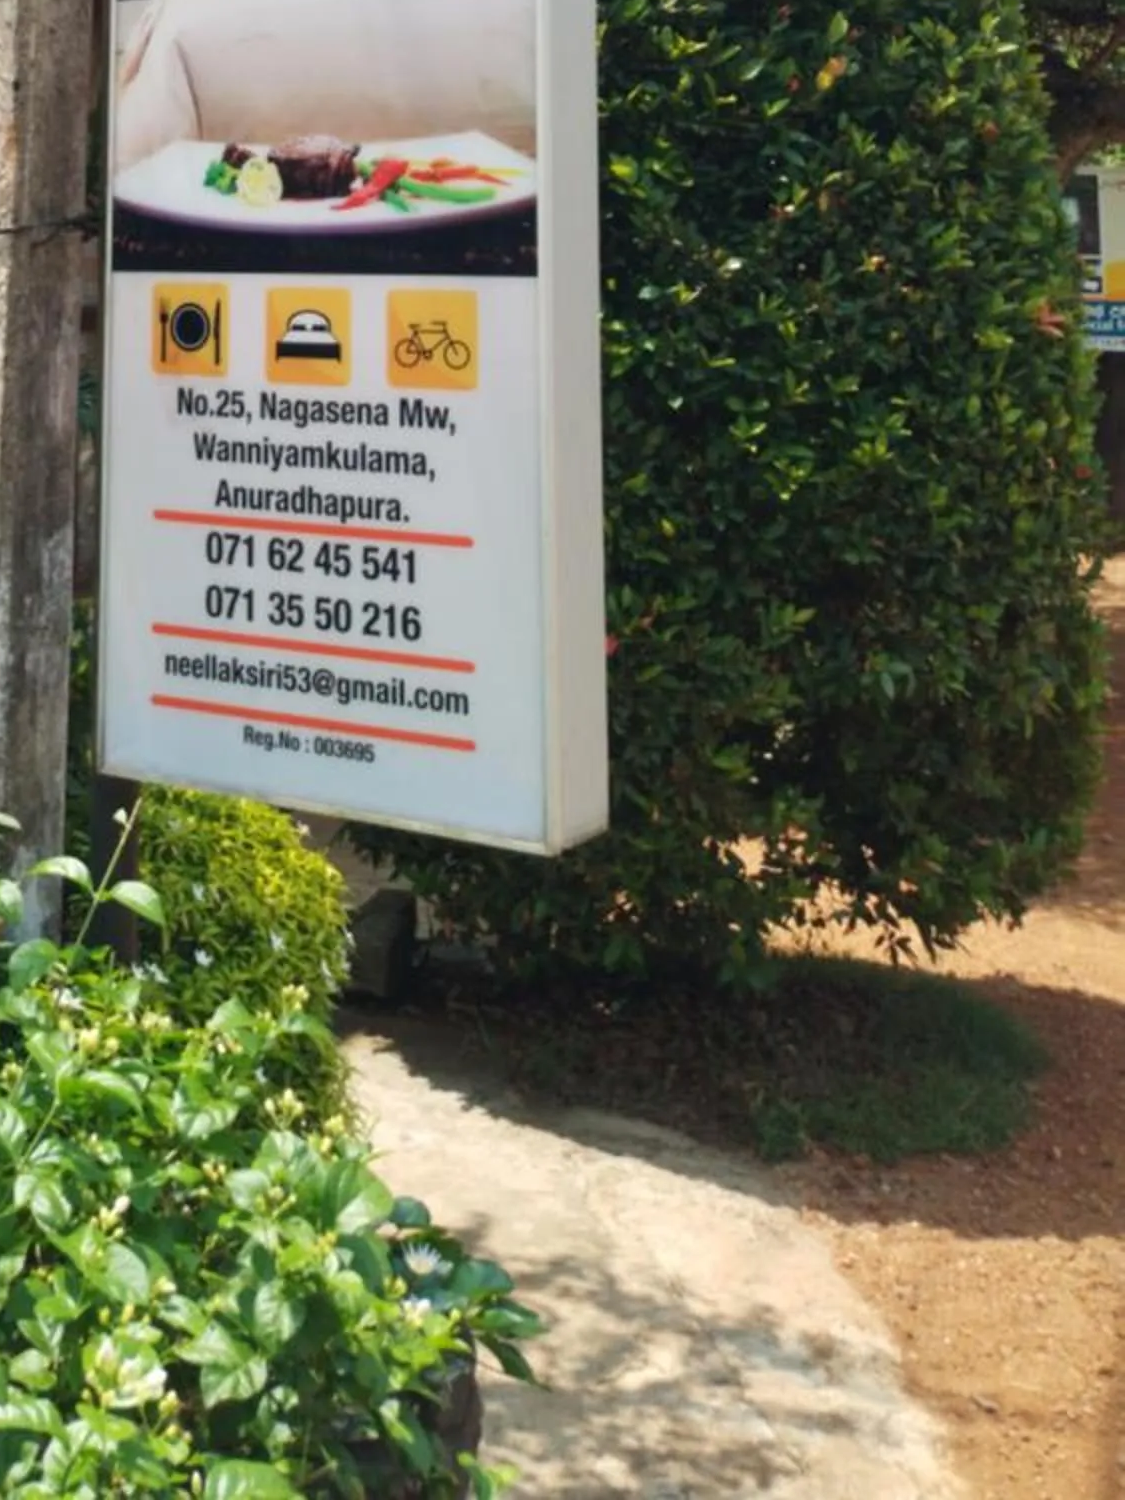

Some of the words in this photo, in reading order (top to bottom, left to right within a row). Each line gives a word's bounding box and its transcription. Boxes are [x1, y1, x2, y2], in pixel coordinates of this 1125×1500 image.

[177, 387, 253, 423] No.25,
[260, 392, 389, 428] Nagasena
[399, 398, 456, 435] Mw,
[193, 432, 436, 481] Wanniyamkulama,
[214, 479, 410, 524] Anuradhapura.
[205, 531, 255, 568] 071
[268, 537, 304, 573] 62
[314, 541, 352, 578] 45
[362, 546, 416, 584] 541
[205, 585, 255, 622] 071
[268, 591, 304, 628] 35
[314, 597, 352, 633] 50
[362, 602, 422, 641] 216
[164, 651, 470, 716] neellaksiri53@gmail.com
